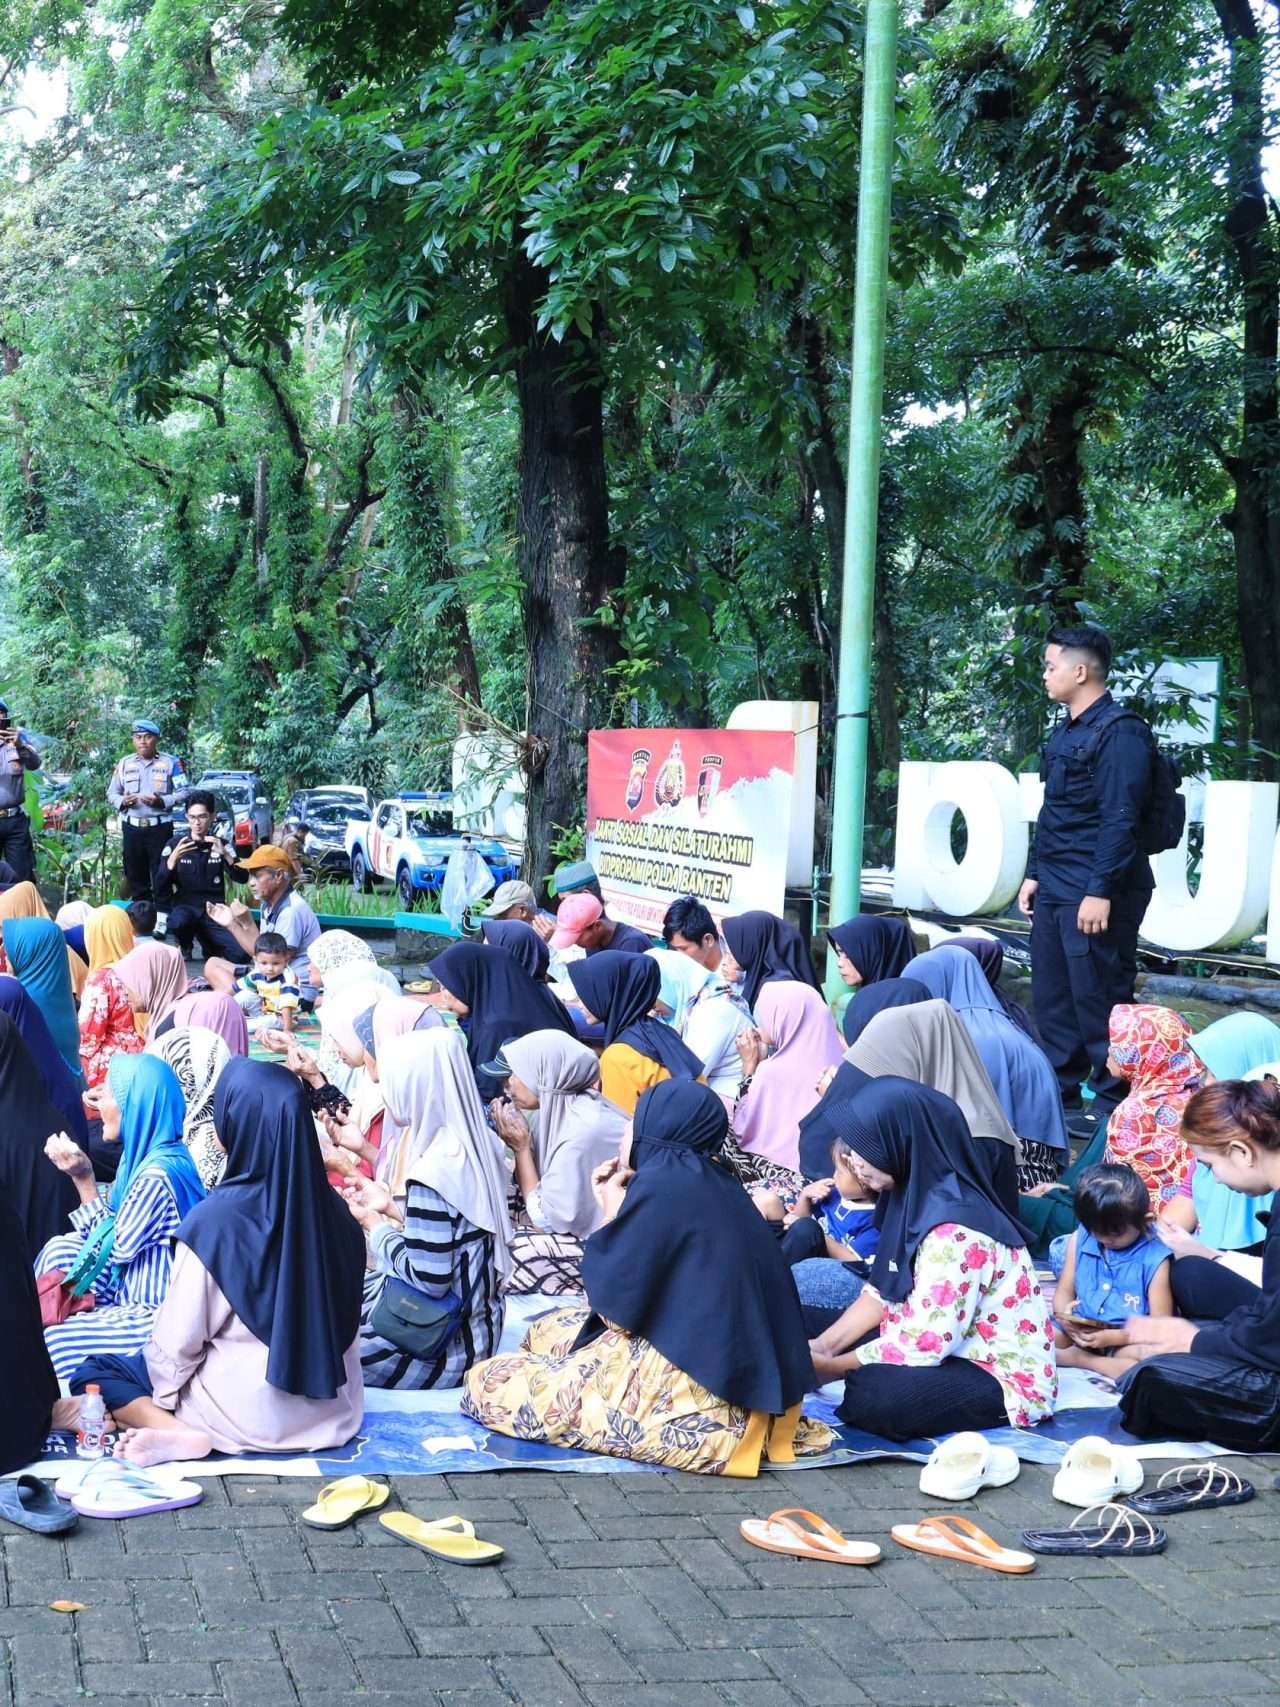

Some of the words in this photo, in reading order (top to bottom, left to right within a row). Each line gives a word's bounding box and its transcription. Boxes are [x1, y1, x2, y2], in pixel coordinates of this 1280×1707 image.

[616, 819, 649, 849] SOSIAL
[648, 823, 674, 853] DAN
[671, 826, 754, 867] SILATURAHMI
[644, 859, 680, 892] POLDA
[678, 864, 733, 903] BANTEN
